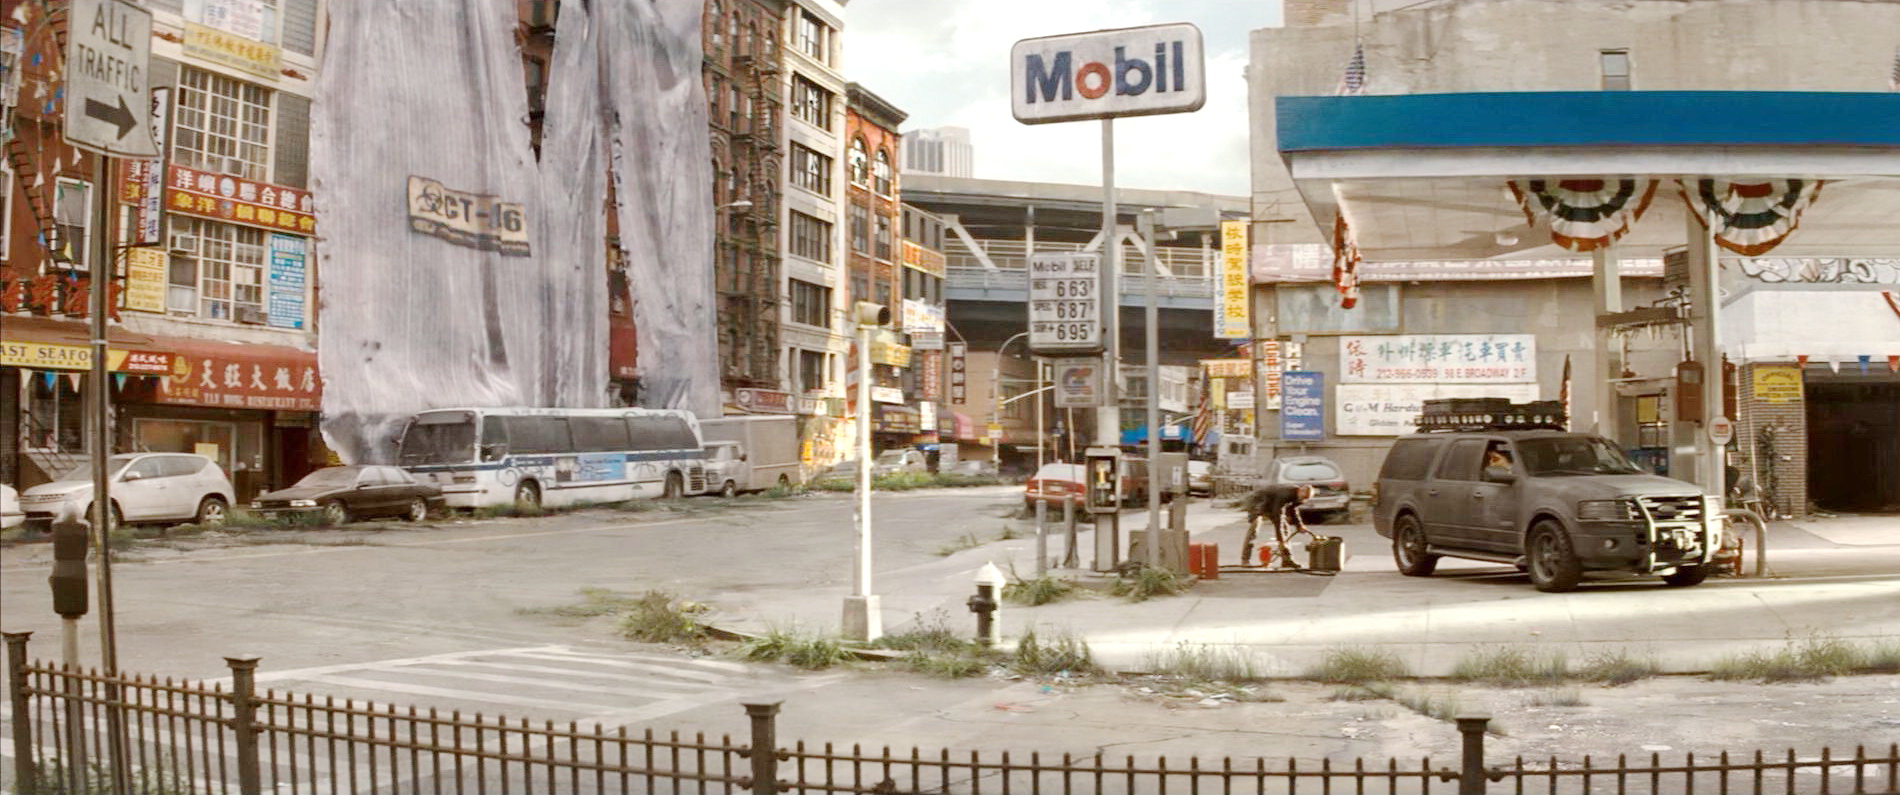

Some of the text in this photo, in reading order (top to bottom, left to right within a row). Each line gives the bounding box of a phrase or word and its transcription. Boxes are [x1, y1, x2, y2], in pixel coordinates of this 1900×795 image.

[92, 3, 133, 50] ALL
[77, 43, 140, 94] TRAFFIC
[1025, 40, 1185, 104] Mobil
[1033, 259, 1096, 272] Mobil SELF
[37, 347, 93, 361] SEAFO
[1464, 367, 1510, 378] BROADWAY
[1284, 376, 1313, 385] Drive
[1285, 386, 1309, 395] Your
[1285, 395, 1321, 408] Engine
